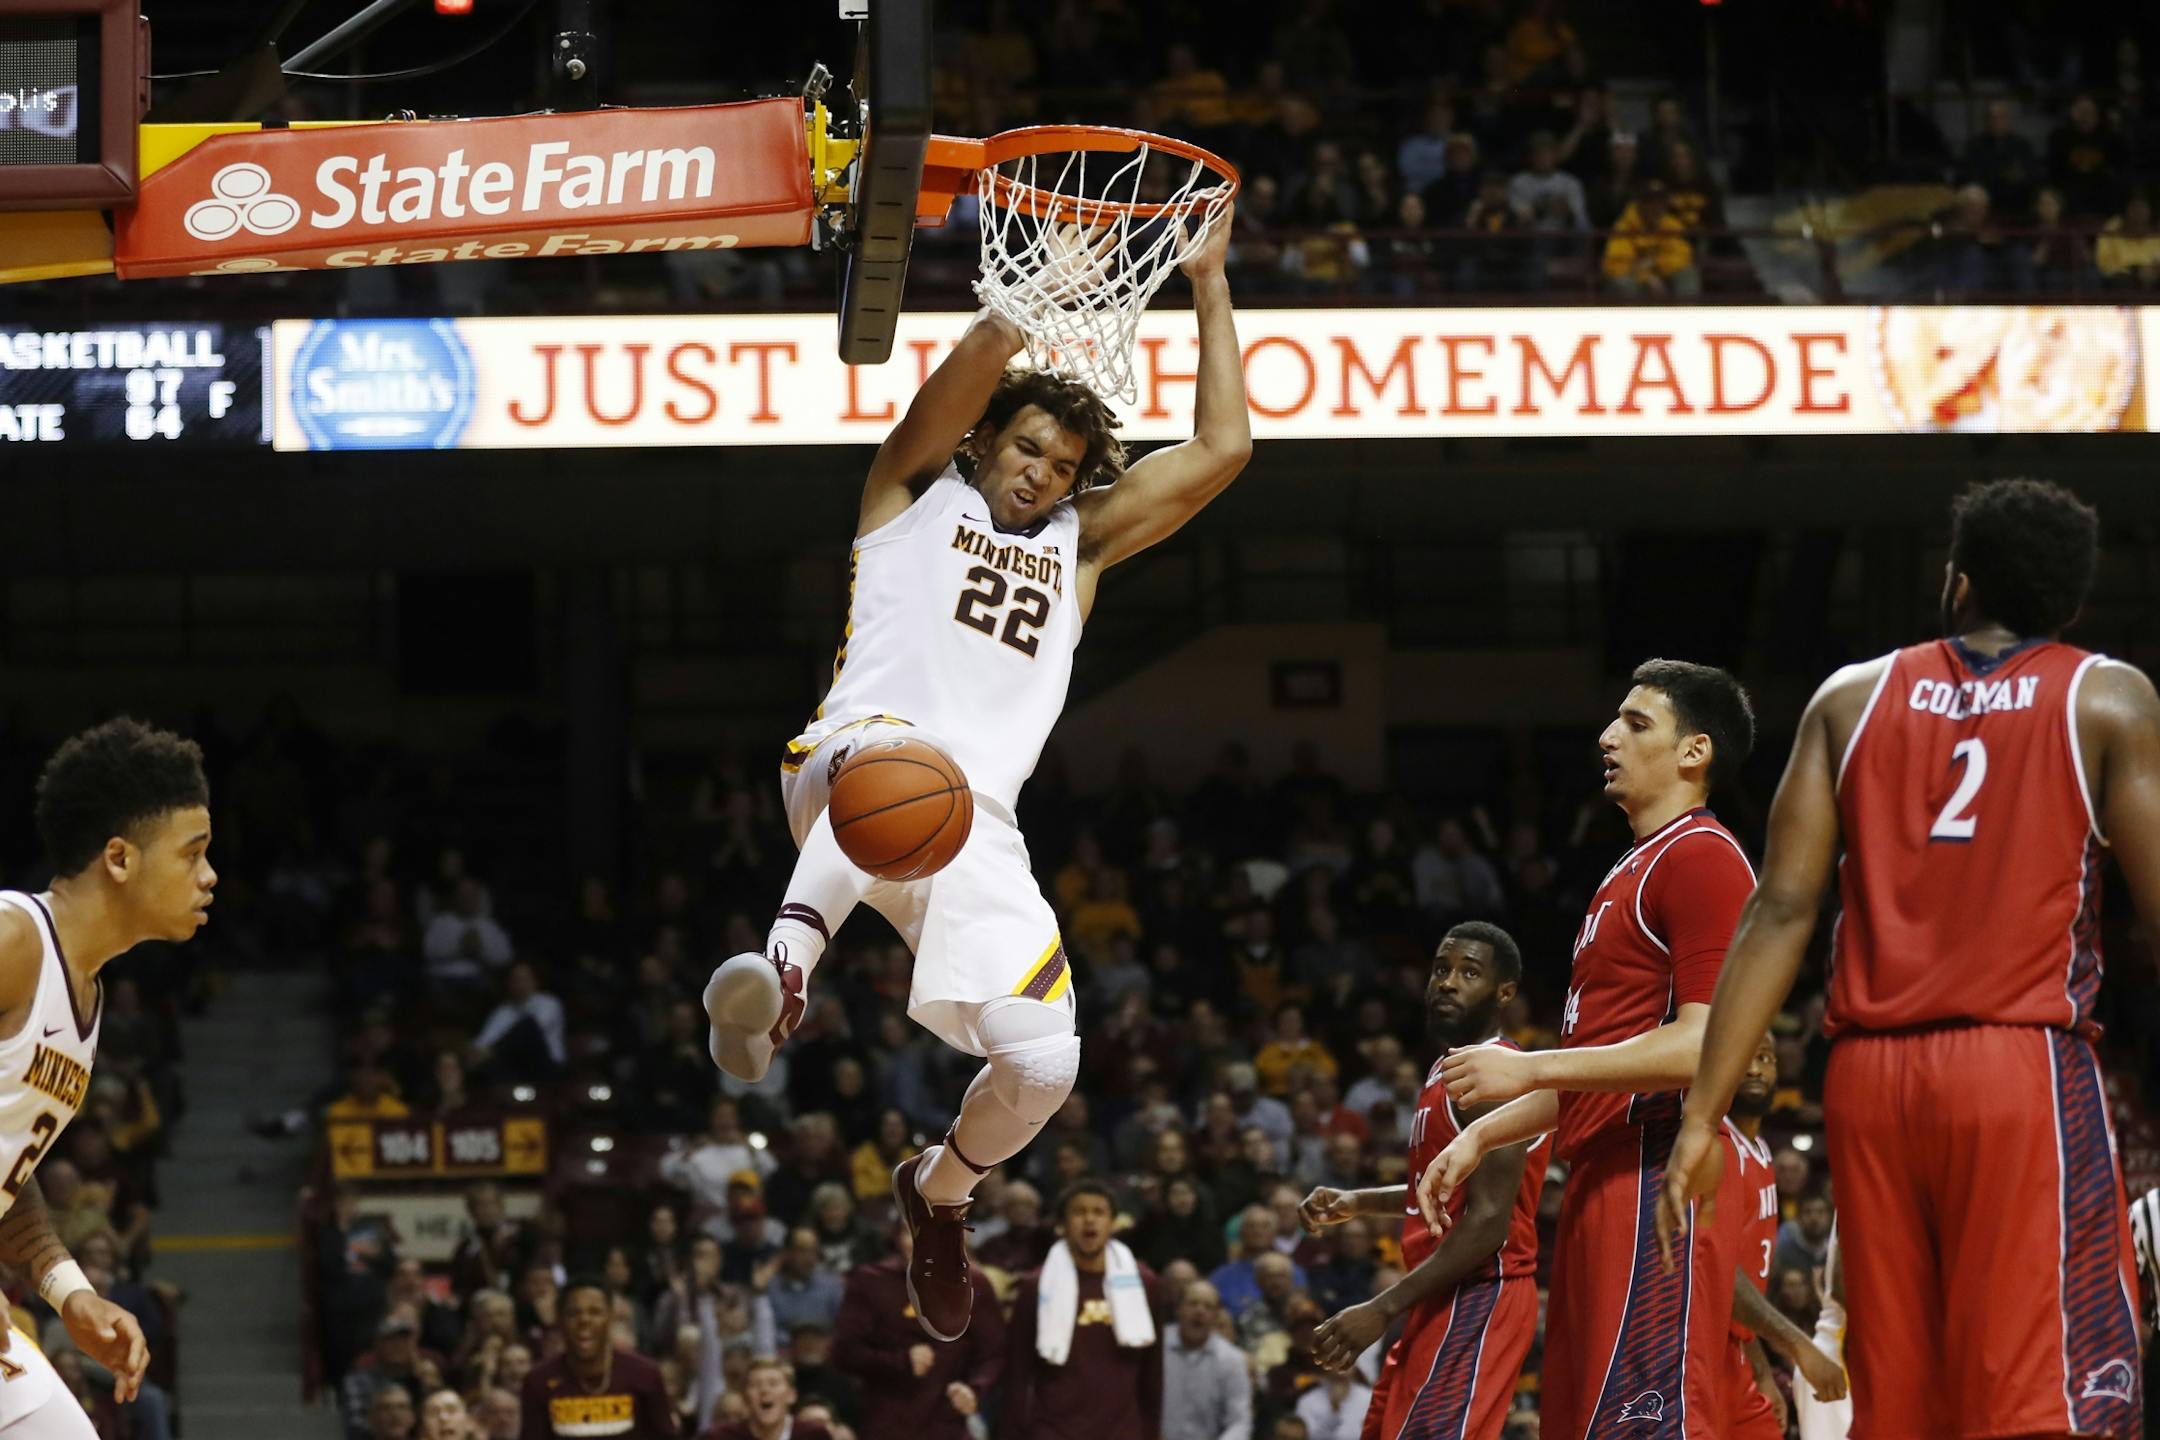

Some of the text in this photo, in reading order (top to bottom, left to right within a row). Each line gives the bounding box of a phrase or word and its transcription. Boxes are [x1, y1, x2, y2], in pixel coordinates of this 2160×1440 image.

[209, 381, 236, 418] F
[507, 342, 800, 426] JUST
[1137, 332, 1852, 420] HOMEMADE
[953, 565, 1051, 660] 22
[1929, 737, 1988, 842] 2
[1, 1110, 58, 1197] 2
